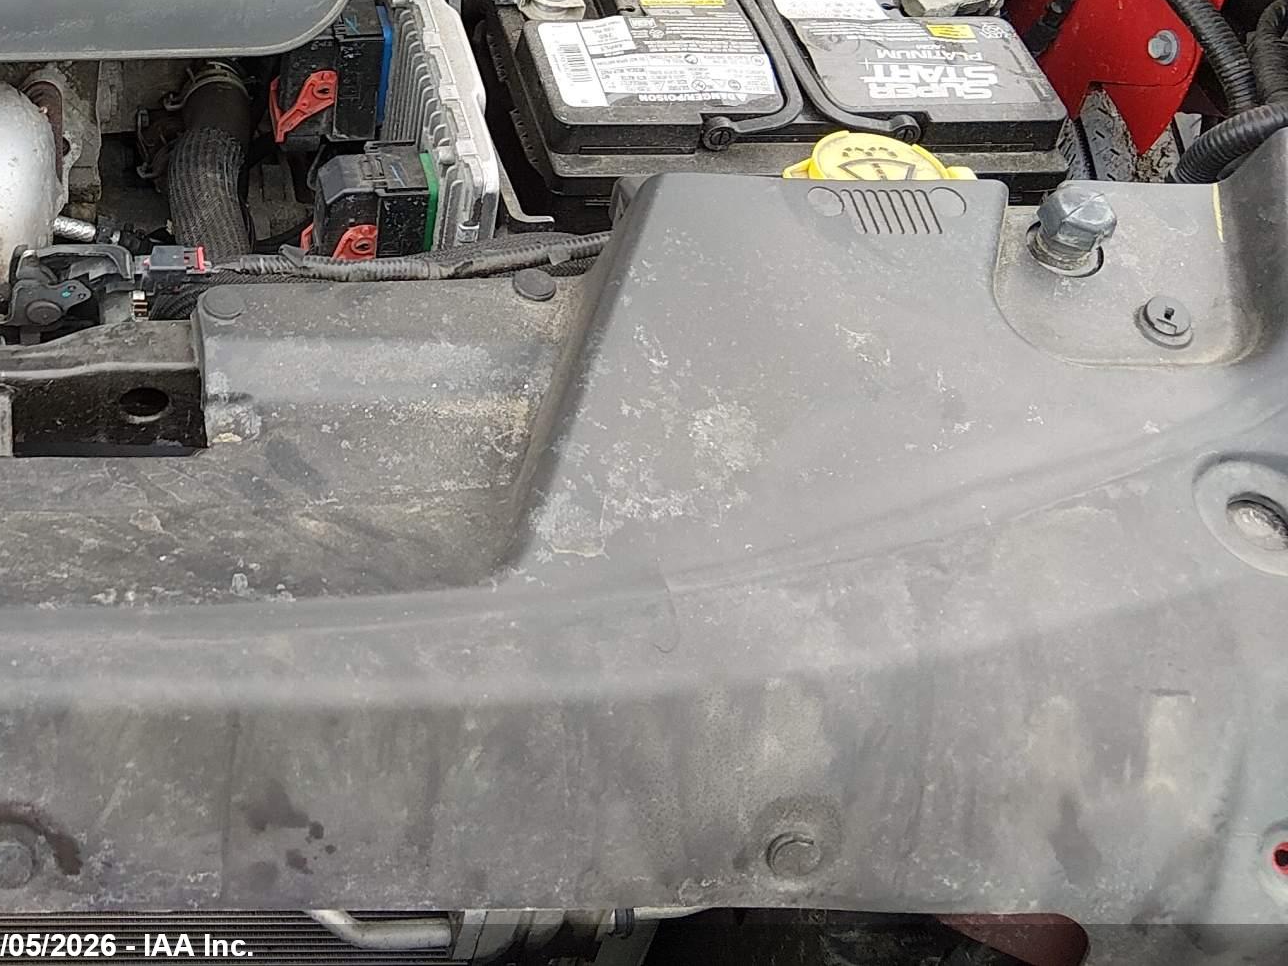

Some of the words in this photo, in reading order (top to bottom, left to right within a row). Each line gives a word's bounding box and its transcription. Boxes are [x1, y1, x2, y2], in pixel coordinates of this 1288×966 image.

[876, 48, 983, 61] PLATINUM
[859, 65, 998, 86] START
[868, 82, 993, 100] SUPER
